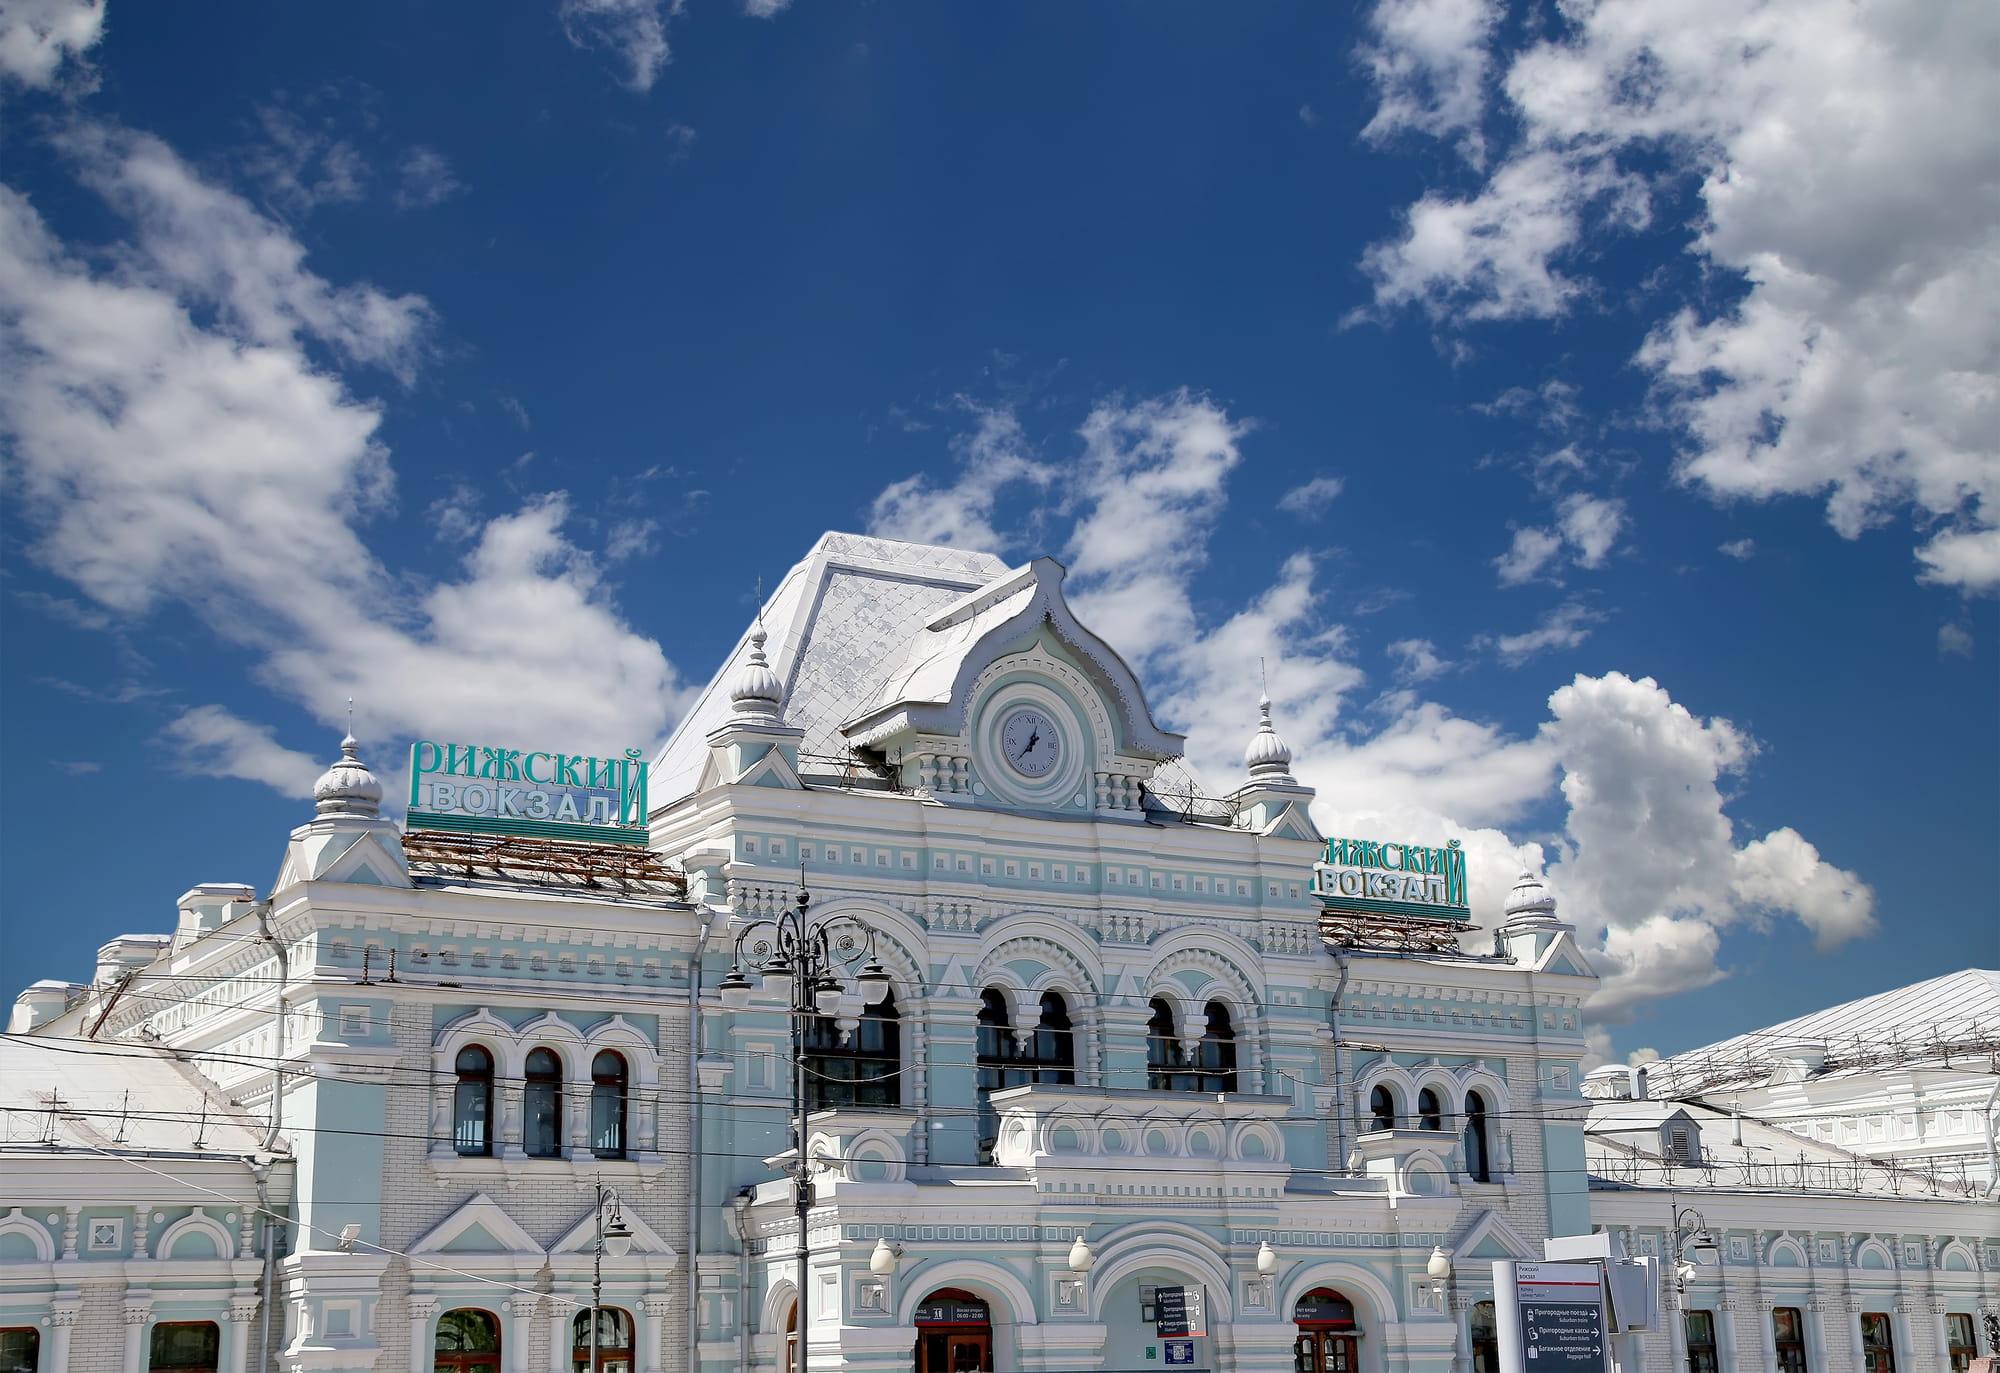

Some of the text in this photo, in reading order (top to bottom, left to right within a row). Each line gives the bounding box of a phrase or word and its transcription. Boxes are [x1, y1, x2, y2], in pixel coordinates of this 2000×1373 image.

[408, 740, 649, 827] РИЖСКИЙ
[431, 781, 611, 825] ВОКЗАЛ
[1310, 837, 1470, 906] ИЖСКИЙ
[1320, 868, 1443, 903] ВОКЗАЛ
[1539, 1327, 1574, 1335] Пригородные
